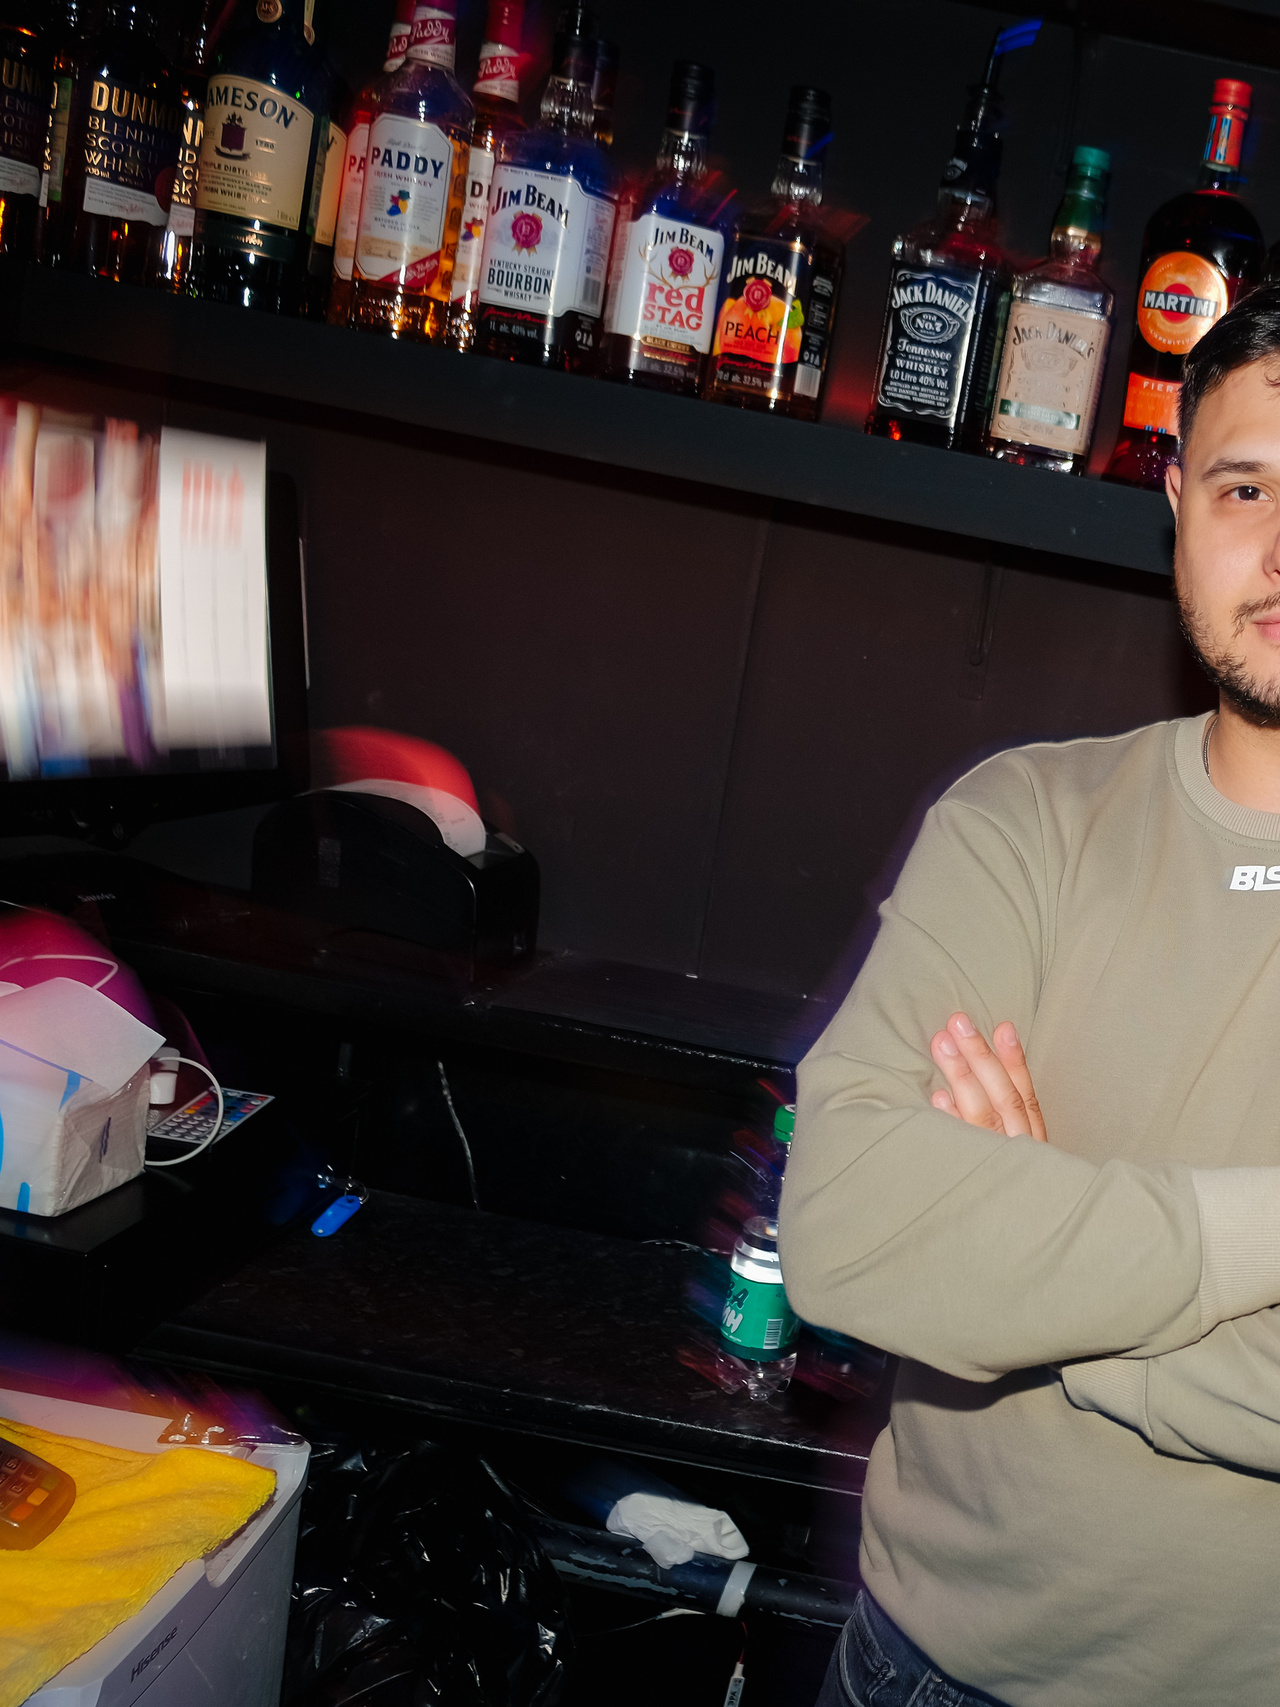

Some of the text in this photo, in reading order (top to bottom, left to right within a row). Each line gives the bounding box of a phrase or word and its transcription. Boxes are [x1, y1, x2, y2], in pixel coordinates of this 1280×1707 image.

[410, 19, 450, 41] Paddy
[387, 36, 408, 58] Pad
[478, 58, 517, 79] Paddy
[90, 80, 184, 135] DUNMO
[371, 147, 444, 179] PADDY
[491, 186, 521, 216] JIM
[524, 184, 570, 230] BEAM
[648, 227, 715, 263] JIM BEAM
[489, 258, 555, 277] KENTUCKY STRAIGHT
[726, 252, 797, 297] JIM BEAM
[487, 267, 553, 296] BOURBON
[504, 289, 532, 302] WHISKEY
[646, 282, 705, 314] red
[892, 285, 924, 310] JACK
[1144, 291, 1216, 317] MARTINI
[643, 303, 703, 331] STAG
[724, 321, 780, 345] PEACH
[1013, 325, 1043, 346] JACK
[897, 338, 952, 362] Tennessee
[896, 357, 948, 377] WHISKEY
[900, 371, 918, 384] Litre
[919, 375, 935, 387] 40%
[936, 378, 949, 390] Vol.
[1143, 381, 1180, 394] FIER
[130, 1626, 178, 1683] Hisense
